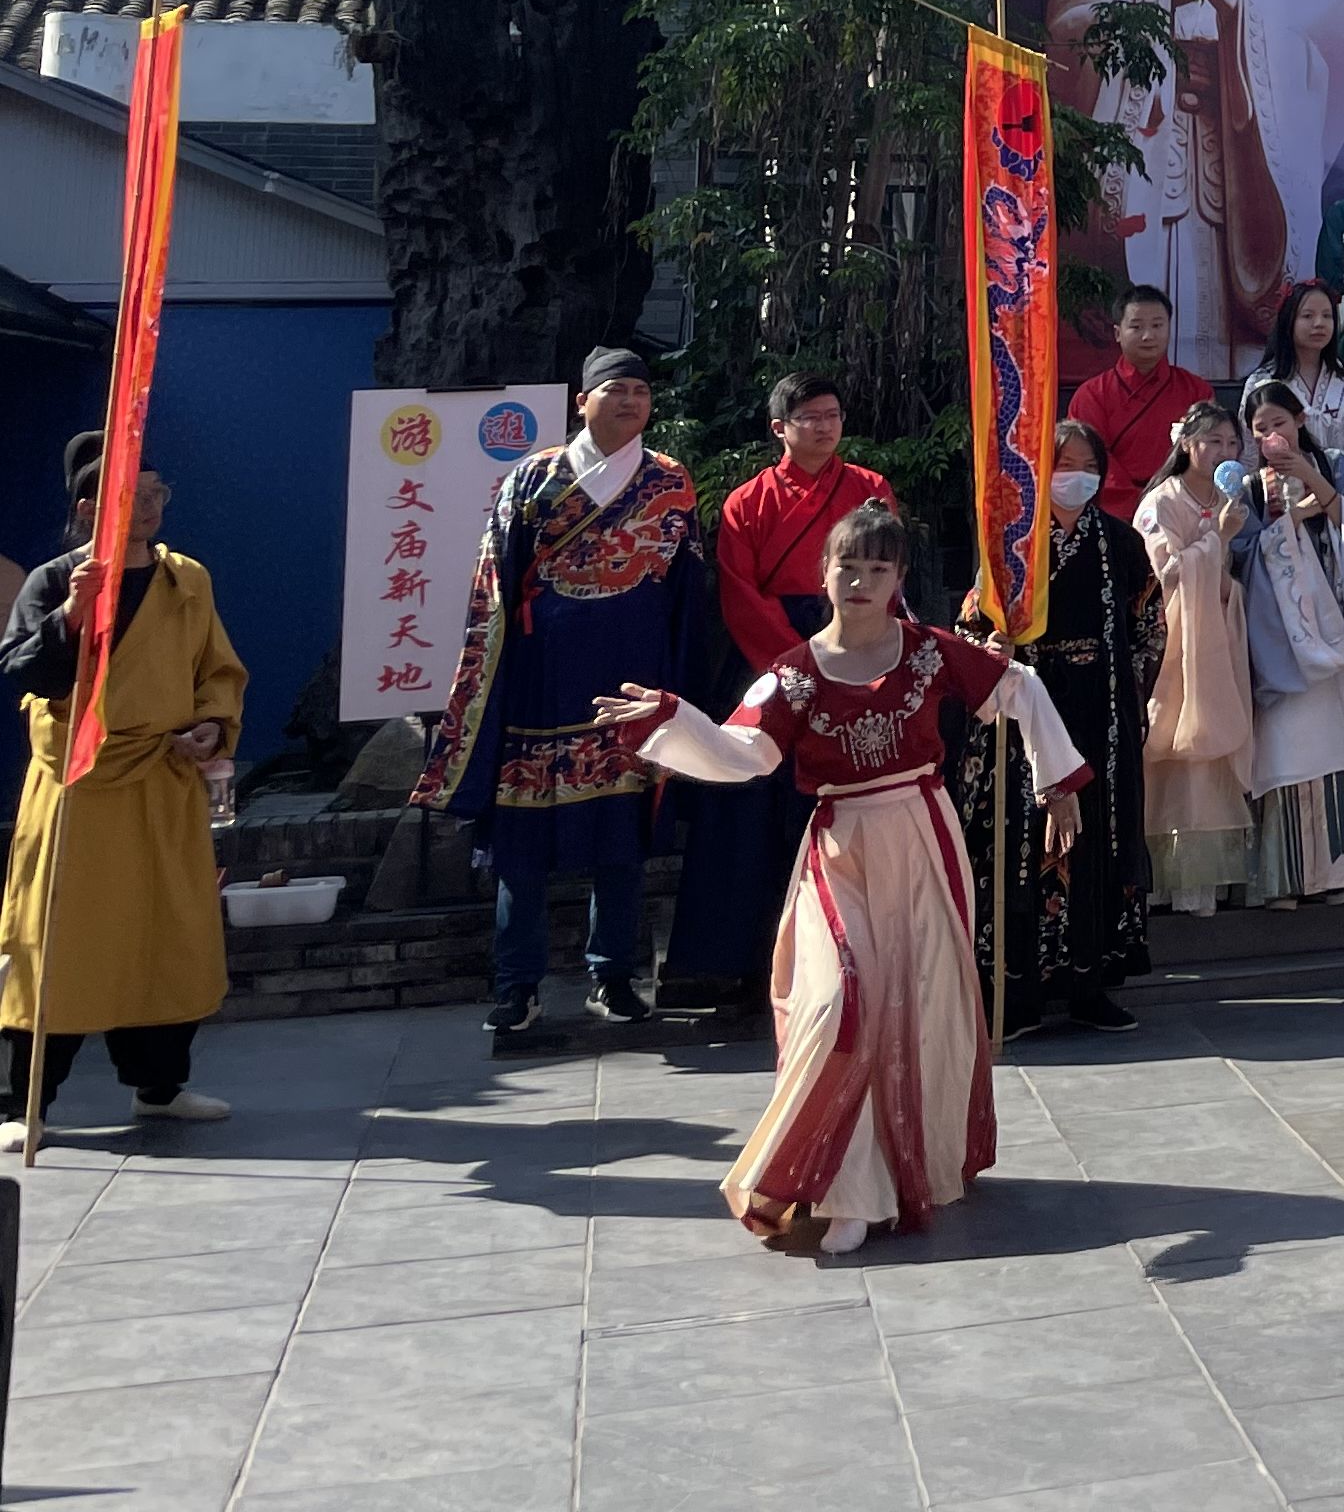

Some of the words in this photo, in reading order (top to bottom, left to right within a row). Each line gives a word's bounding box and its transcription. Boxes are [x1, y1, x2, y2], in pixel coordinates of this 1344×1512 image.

[390, 413, 433, 457] 游
[482, 411, 532, 451] 逛
[377, 478, 435, 693] 文庙新天地
